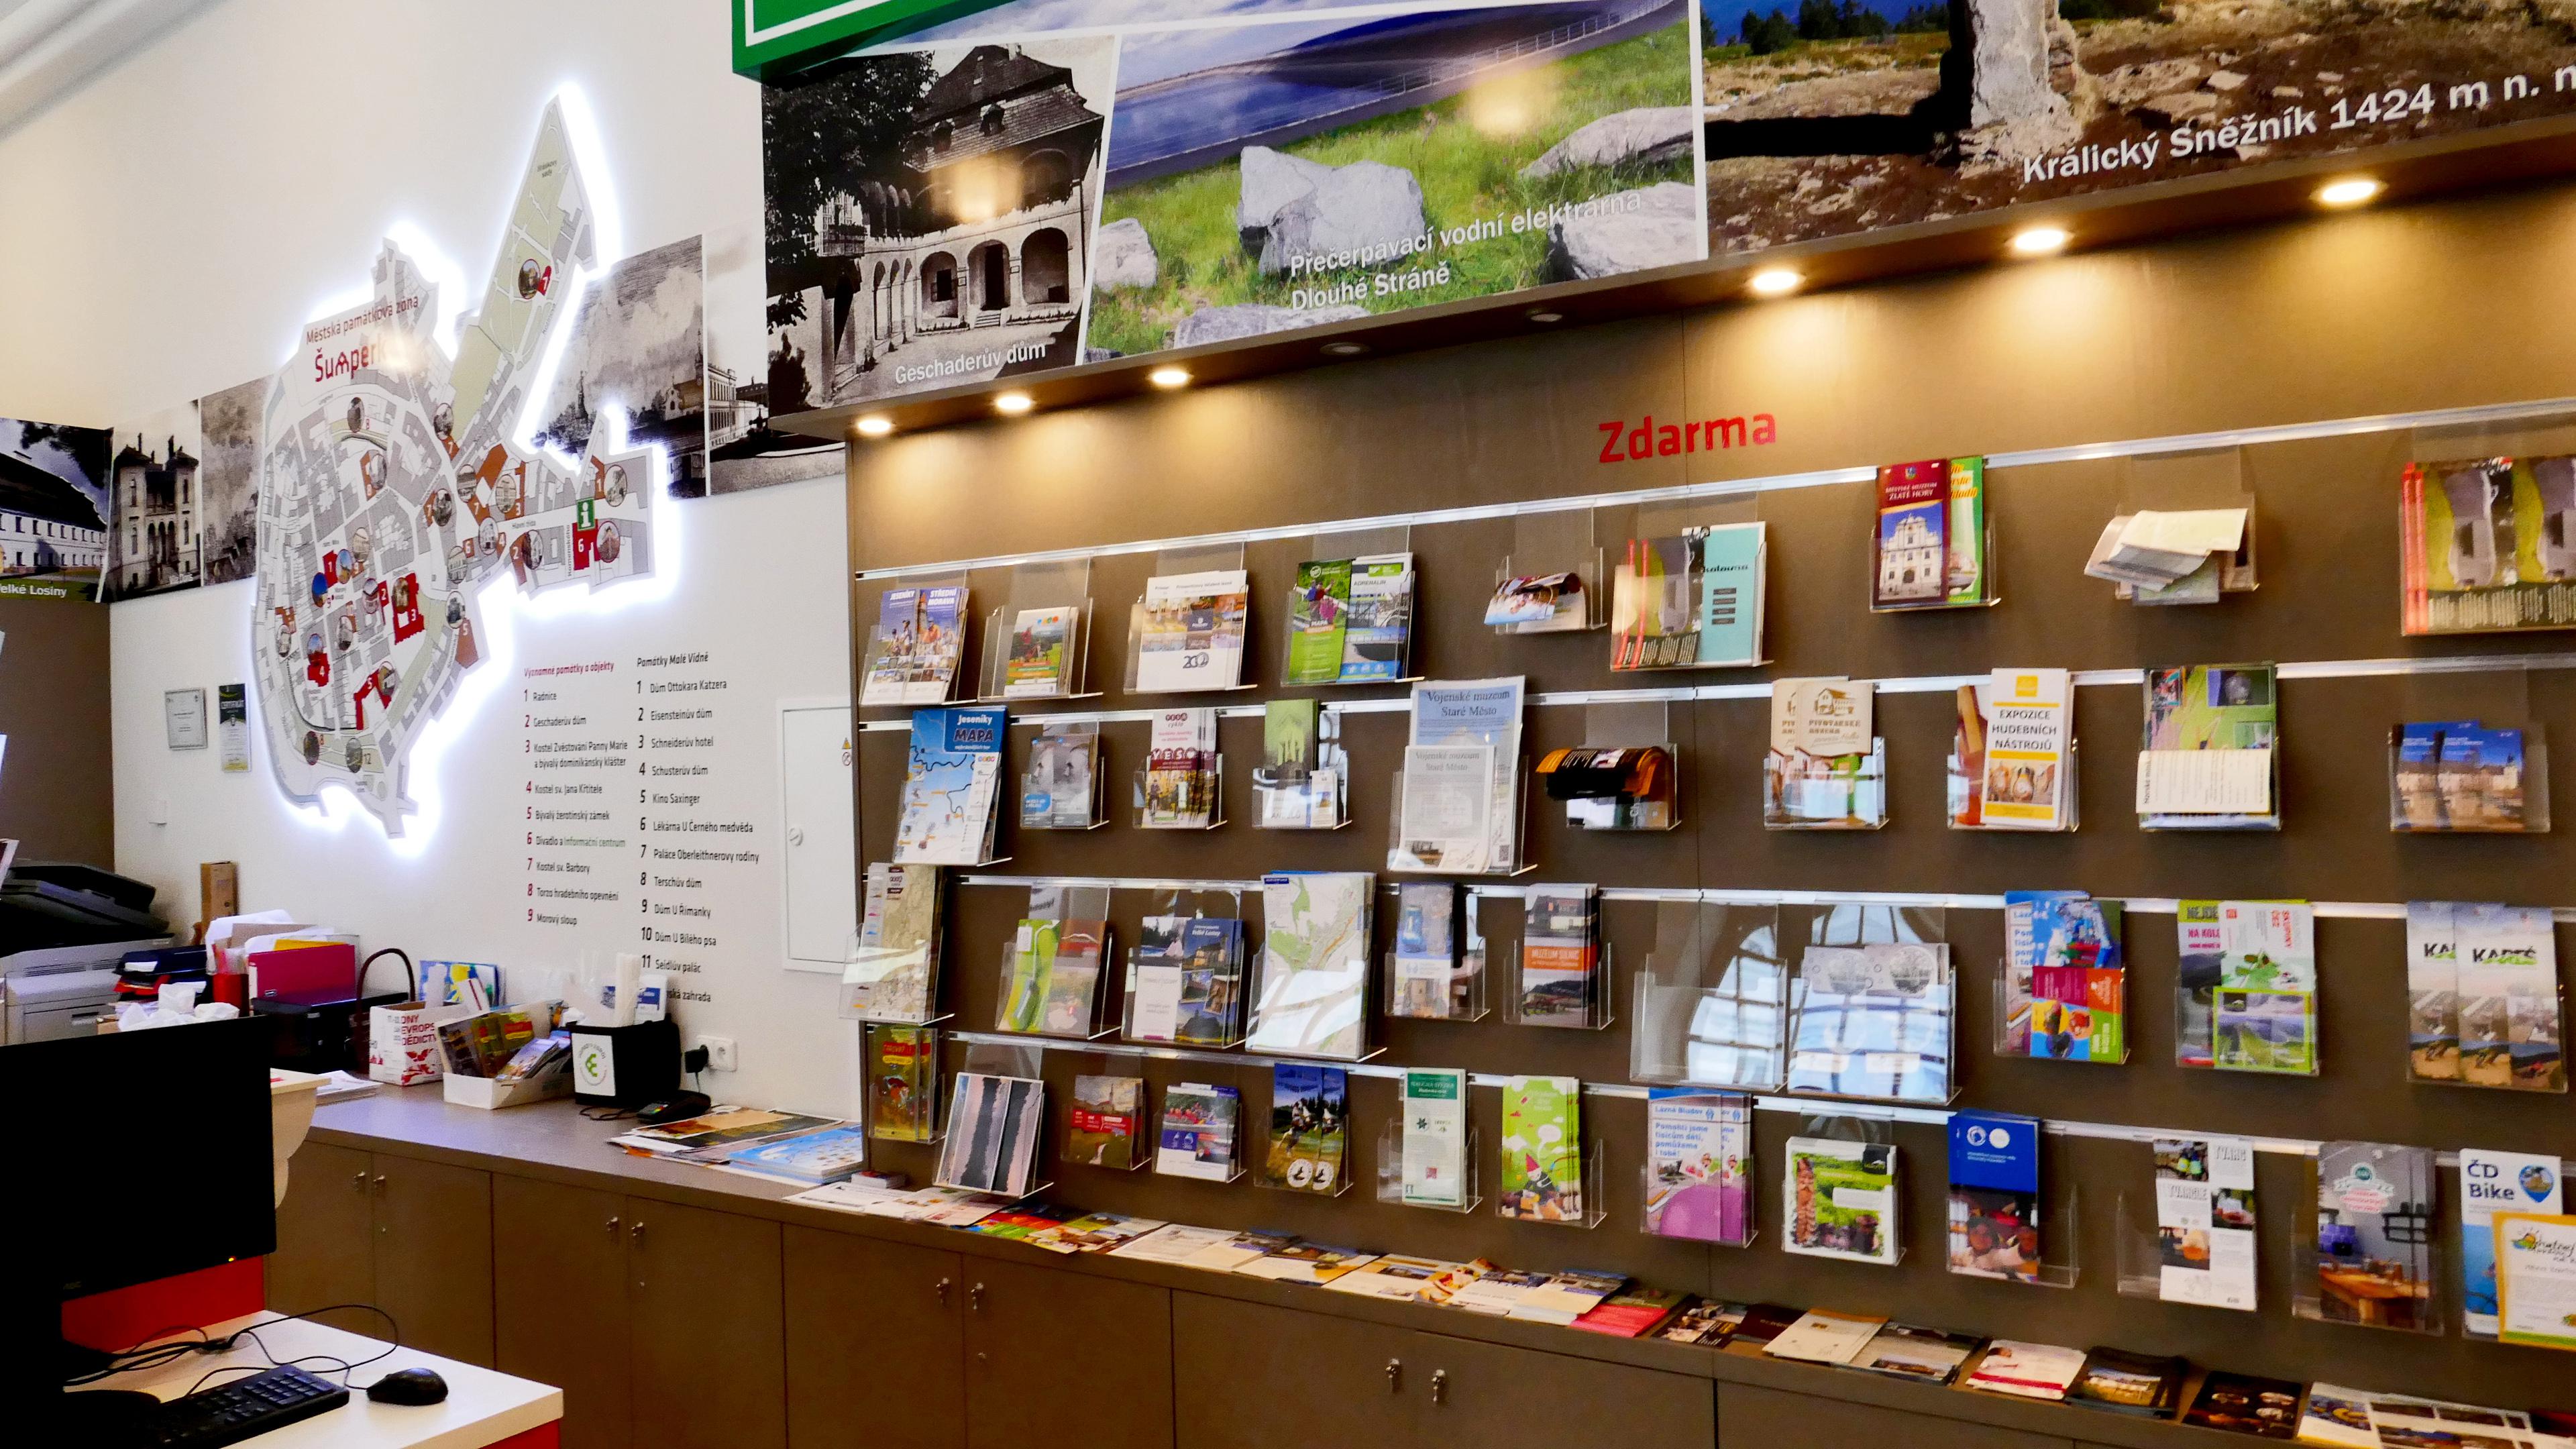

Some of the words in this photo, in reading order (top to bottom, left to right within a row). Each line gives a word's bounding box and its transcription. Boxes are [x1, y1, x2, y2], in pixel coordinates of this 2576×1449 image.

[2023, 132, 2161, 184] Králický
[2169, 106, 2318, 157] Sněžník
[2330, 83, 2436, 131] 1424
[2449, 80, 2488, 111] m
[2504, 74, 2540, 101] n.
[1291, 225, 1433, 277] Přečerpávací
[1439, 212, 1505, 248] vodní
[1511, 192, 1641, 234] elektrárna
[1292, 277, 1368, 311] Dlouhé
[1374, 260, 1450, 297] Stráně
[306, 321, 341, 345] Městská
[343, 303, 393, 335] památková
[396, 296, 419, 315] zóna
[895, 349, 1002, 385] Geschaderův
[1007, 341, 1046, 366] dům
[1599, 413, 1776, 463] Zdarma
[515, 503, 521, 515] 3
[513, 547, 519, 559] 2
[578, 539, 584, 552] 6
[0, 583, 26, 595] elké
[30, 583, 67, 598] Losiny
[381, 588, 386, 600] 2
[411, 609, 416, 621] 3
[637, 655, 668, 667] Památky
[669, 653, 686, 665] Malé
[524, 665, 555, 678] Významné
[556, 663, 583, 677] památky
[585, 664, 589, 672] a
[590, 660, 614, 673] objekty
[637, 680, 641, 694] 1
[650, 682, 666, 693] Dům
[667, 681, 698, 692] Ottokara
[700, 679, 727, 690] Katzera
[524, 689, 528, 702] 1
[533, 691, 557, 701] Radnice
[1428, 690, 1470, 703] Vojenské
[1474, 690, 1509, 702] muzeum
[638, 707, 644, 721] 2
[651, 708, 694, 721] Eisensteinův
[696, 708, 712, 718] dům
[1442, 706, 1466, 716] Staré
[1470, 704, 1497, 716] Město
[1999, 709, 2050, 720] EXPOZICE
[525, 714, 530, 728] 2
[572, 714, 586, 725] dům
[953, 729, 994, 743] MAPA
[1992, 723, 2057, 735] HUDEBNÍCH
[525, 740, 530, 753] 3
[534, 743, 552, 752] Kostel
[554, 741, 587, 752] Zvěstování
[589, 741, 608, 753] Panny
[609, 740, 628, 751] Marie
[638, 735, 644, 749] 3
[651, 737, 694, 749] Schneiderův
[695, 735, 714, 747] hotel
[1994, 738, 2052, 750] NÁSTROJŮ
[539, 758, 558, 770] bývalý
[559, 757, 602, 769] dominikánský
[604, 756, 626, 767] klášter
[639, 762, 645, 775] 4
[652, 764, 690, 776] Schusterův
[692, 765, 708, 775] dům
[526, 780, 531, 794] 4
[535, 784, 553, 794] Kostel
[555, 786, 563, 794] sv.
[564, 785, 578, 796] Jana
[639, 790, 646, 803] 5
[653, 793, 669, 804] Kino
[670, 793, 700, 806] Saxinger
[527, 806, 532, 819] 5
[535, 810, 555, 822] Bývalý
[590, 810, 610, 820] zámek
[640, 816, 646, 830] 6
[653, 820, 680, 832] Lékárna
[682, 821, 688, 831] U
[689, 818, 718, 832] Černého
[719, 822, 753, 833] medvěda
[527, 832, 532, 845] 6
[536, 836, 558, 845] Divadlo
[598, 839, 626, 847] centrum
[641, 844, 647, 858] 7
[653, 848, 676, 859] Paláce
[677, 849, 734, 863] Oberleithnerovy
[736, 851, 759, 864] rodiny
[527, 857, 533, 871] 7
[536, 861, 555, 871] Kostel
[556, 863, 564, 871] sv.
[566, 863, 590, 875] Barbory
[640, 871, 647, 885] 8
[654, 876, 685, 888] Terschův
[686, 877, 702, 888] dům
[527, 883, 533, 896] 8
[537, 887, 553, 897] Torzo
[590, 891, 619, 902] opevnění
[641, 899, 647, 913] 9
[654, 904, 671, 914] Dům
[672, 904, 678, 915] U
[679, 902, 711, 920] Římanky
[527, 908, 533, 922] 9
[537, 913, 560, 925] Morový
[560, 914, 578, 927] sloup
[641, 926, 652, 941] 10
[655, 931, 672, 943] Dům
[673, 933, 678, 943] U
[680, 933, 702, 945] Bílého
[704, 937, 716, 947] psa
[641, 955, 651, 968] 11
[655, 959, 682, 971] Seidlův
[682, 961, 701, 973] palác
[682, 990, 711, 1002] zahrada
[2467, 1159, 2499, 1179] ČD
[2469, 1182, 2515, 1200] Bike
